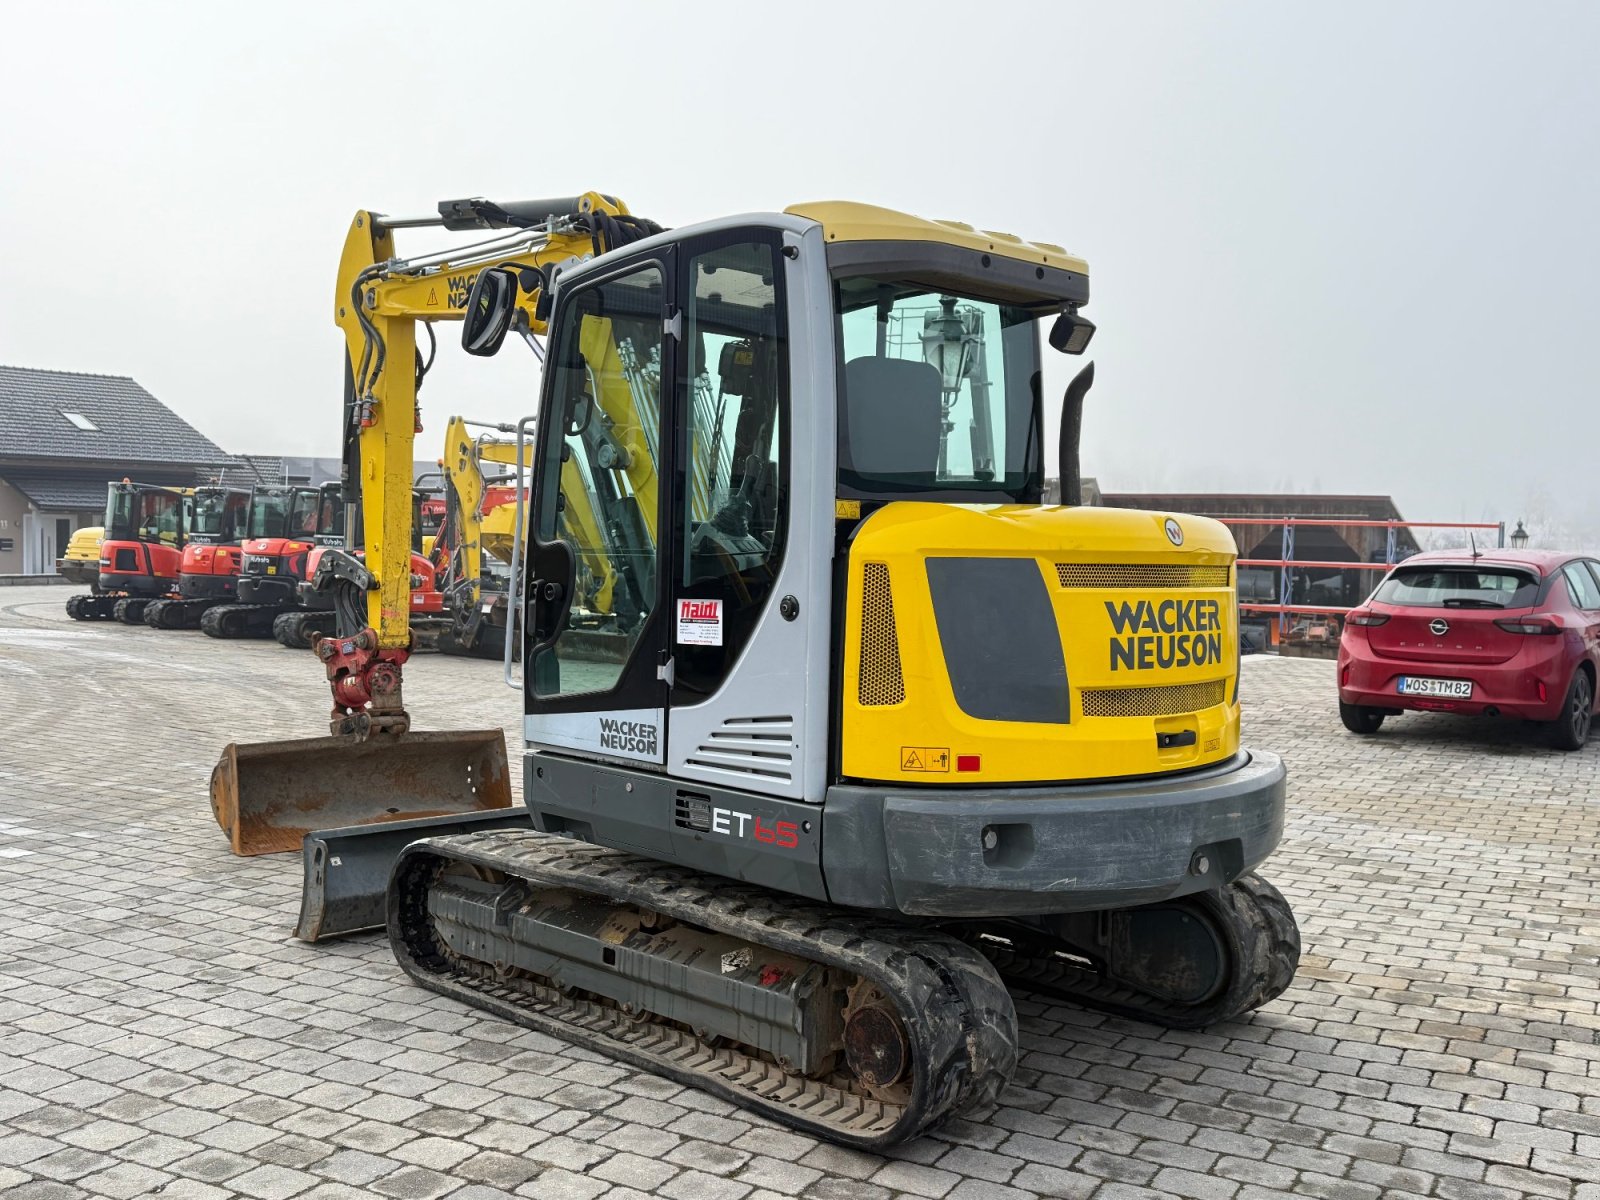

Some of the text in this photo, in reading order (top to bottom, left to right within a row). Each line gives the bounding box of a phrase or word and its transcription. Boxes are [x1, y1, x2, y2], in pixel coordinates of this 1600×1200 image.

[1104, 599, 1221, 635] WACKER
[1110, 633, 1221, 671] NEUSON
[1405, 679, 1429, 692] WOS
[1437, 681, 1454, 693] TM
[1454, 682, 1471, 695] 82
[599, 717, 657, 741] WACKER
[600, 732, 658, 756] NEUSON
